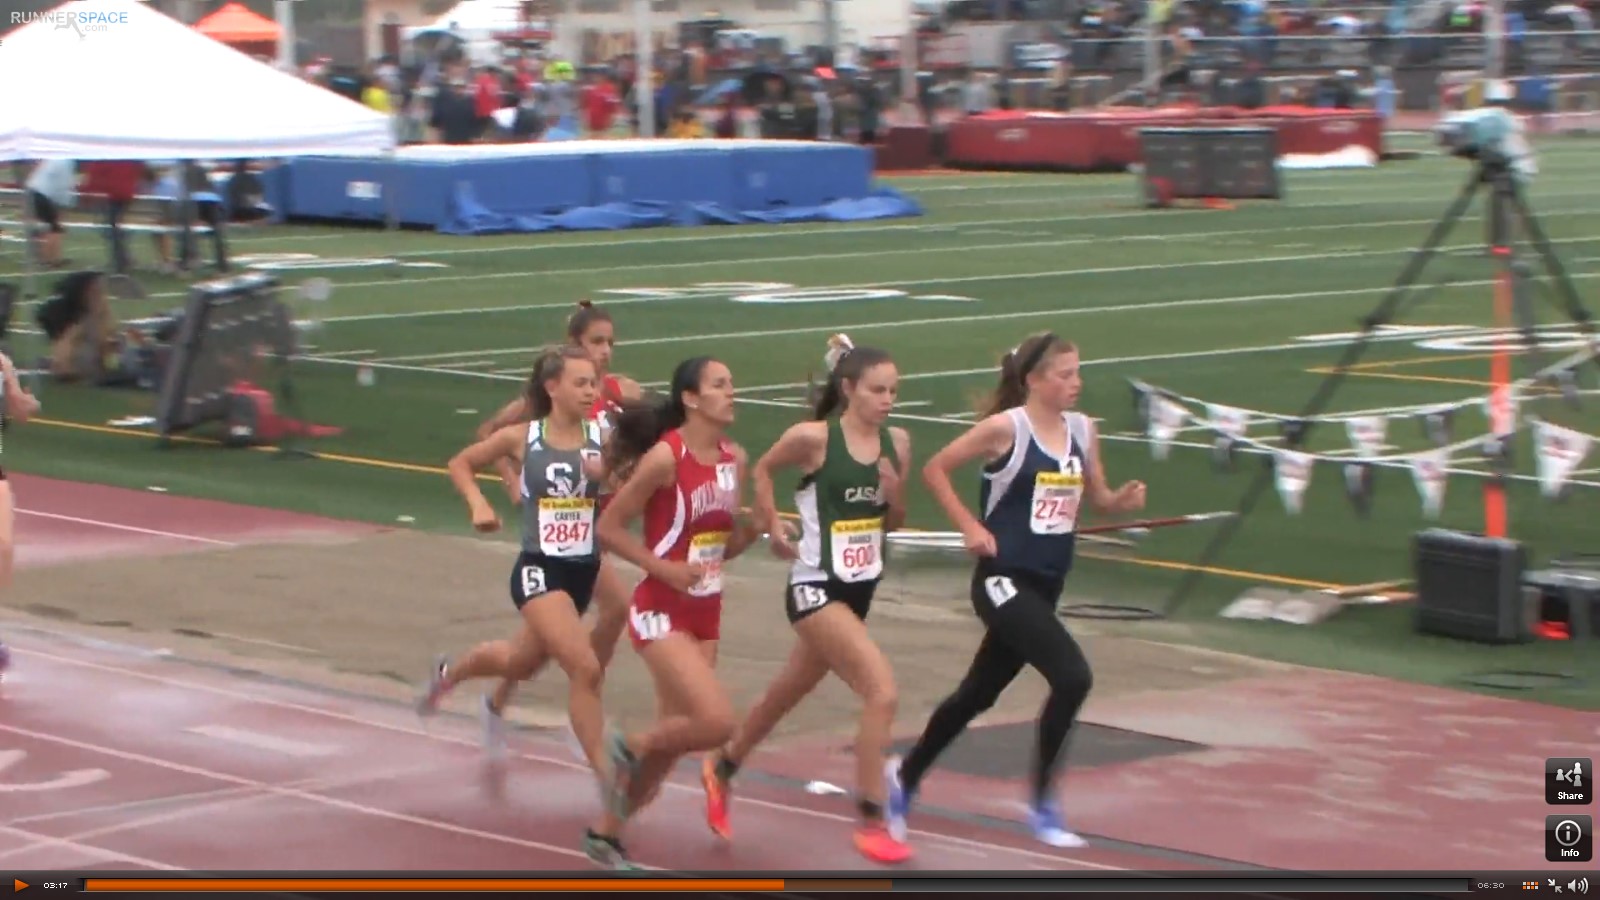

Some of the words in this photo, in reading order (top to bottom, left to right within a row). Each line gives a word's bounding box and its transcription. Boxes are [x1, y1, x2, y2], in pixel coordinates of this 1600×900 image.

[1034, 498, 1075, 520] 274
[543, 522, 590, 543] 2847
[527, 567, 541, 592] 5
